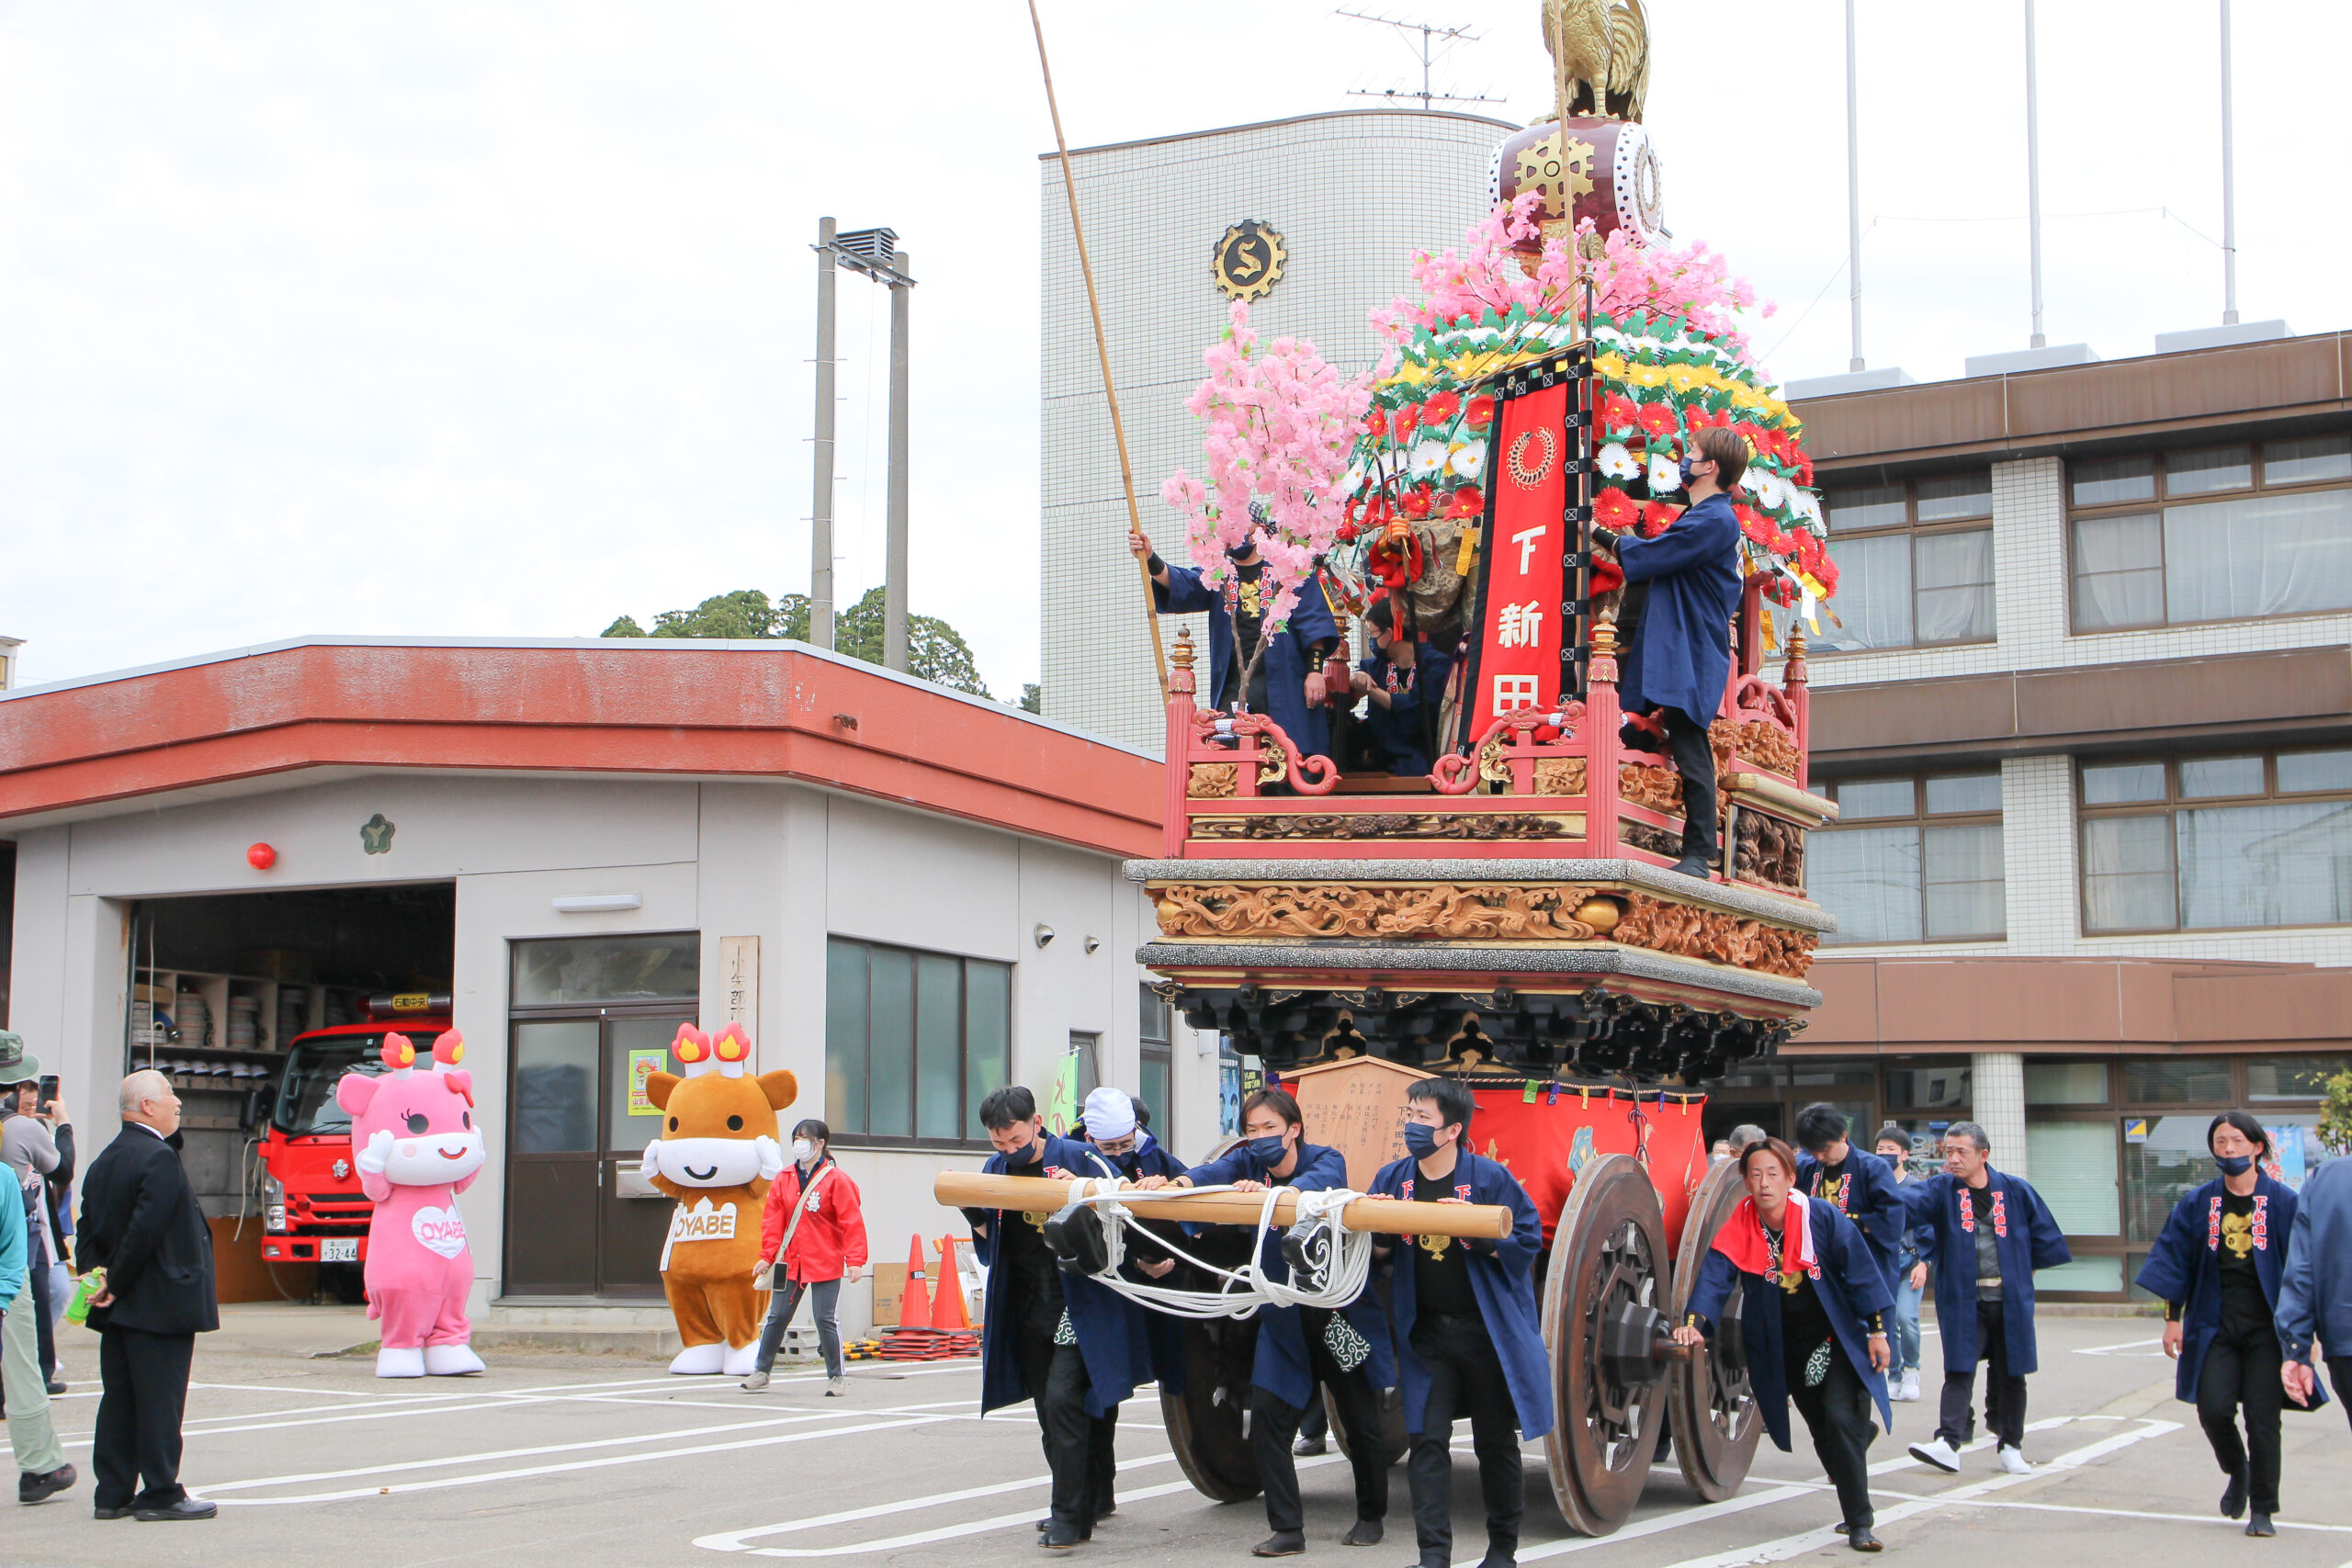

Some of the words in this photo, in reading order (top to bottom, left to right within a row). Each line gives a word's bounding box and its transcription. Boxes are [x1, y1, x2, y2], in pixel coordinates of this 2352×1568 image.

[1493, 525, 1546, 717] 下新田
[1957, 1188, 1974, 1233] 下新田町
[1991, 1190, 2007, 1237] 下新田町
[2252, 1195, 2267, 1250] 下新田町
